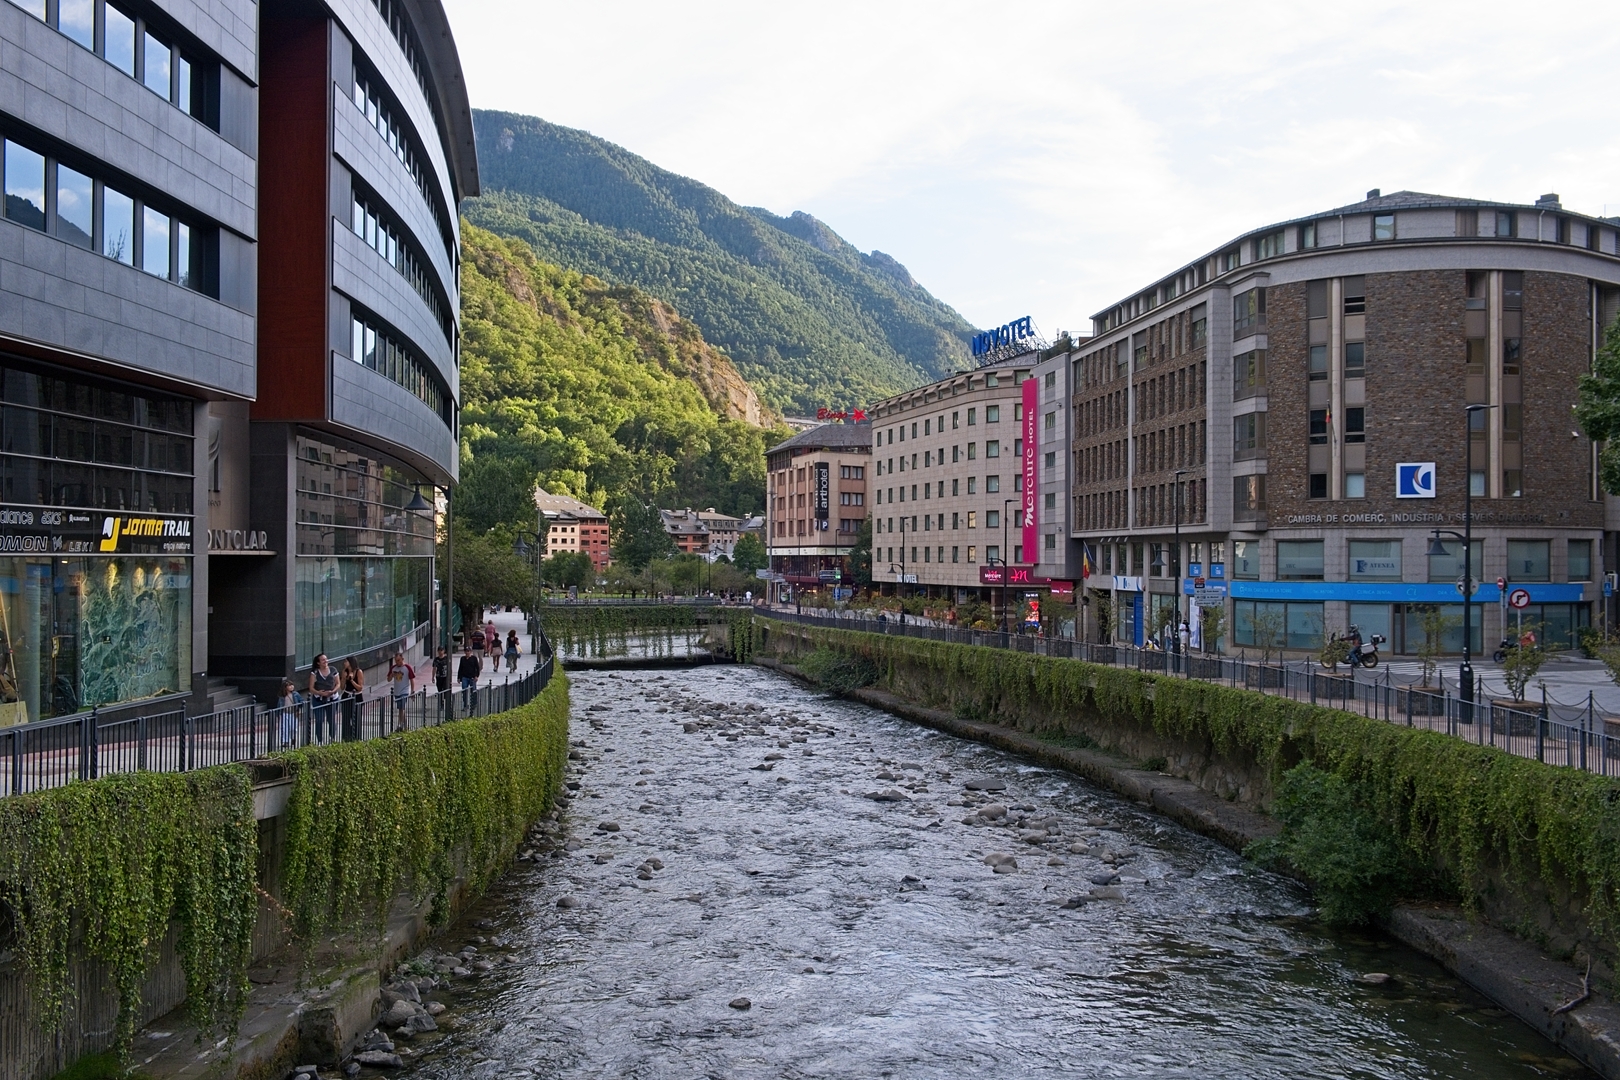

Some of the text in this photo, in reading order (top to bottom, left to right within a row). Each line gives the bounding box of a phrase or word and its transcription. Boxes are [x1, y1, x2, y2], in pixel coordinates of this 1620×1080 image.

[972, 315, 1034, 356] NOVOTEL
[817, 407, 848, 422] Bingo
[820, 468, 828, 509] arthotel
[41, 510, 62, 525] asics
[1288, 514, 1322, 523] CAMBRA
[1326, 514, 1338, 523] DE
[1392, 513, 1444, 522] INDUSTRIA
[68, 541, 94, 552] LEKI
[163, 542, 190, 551] enjoy nature
